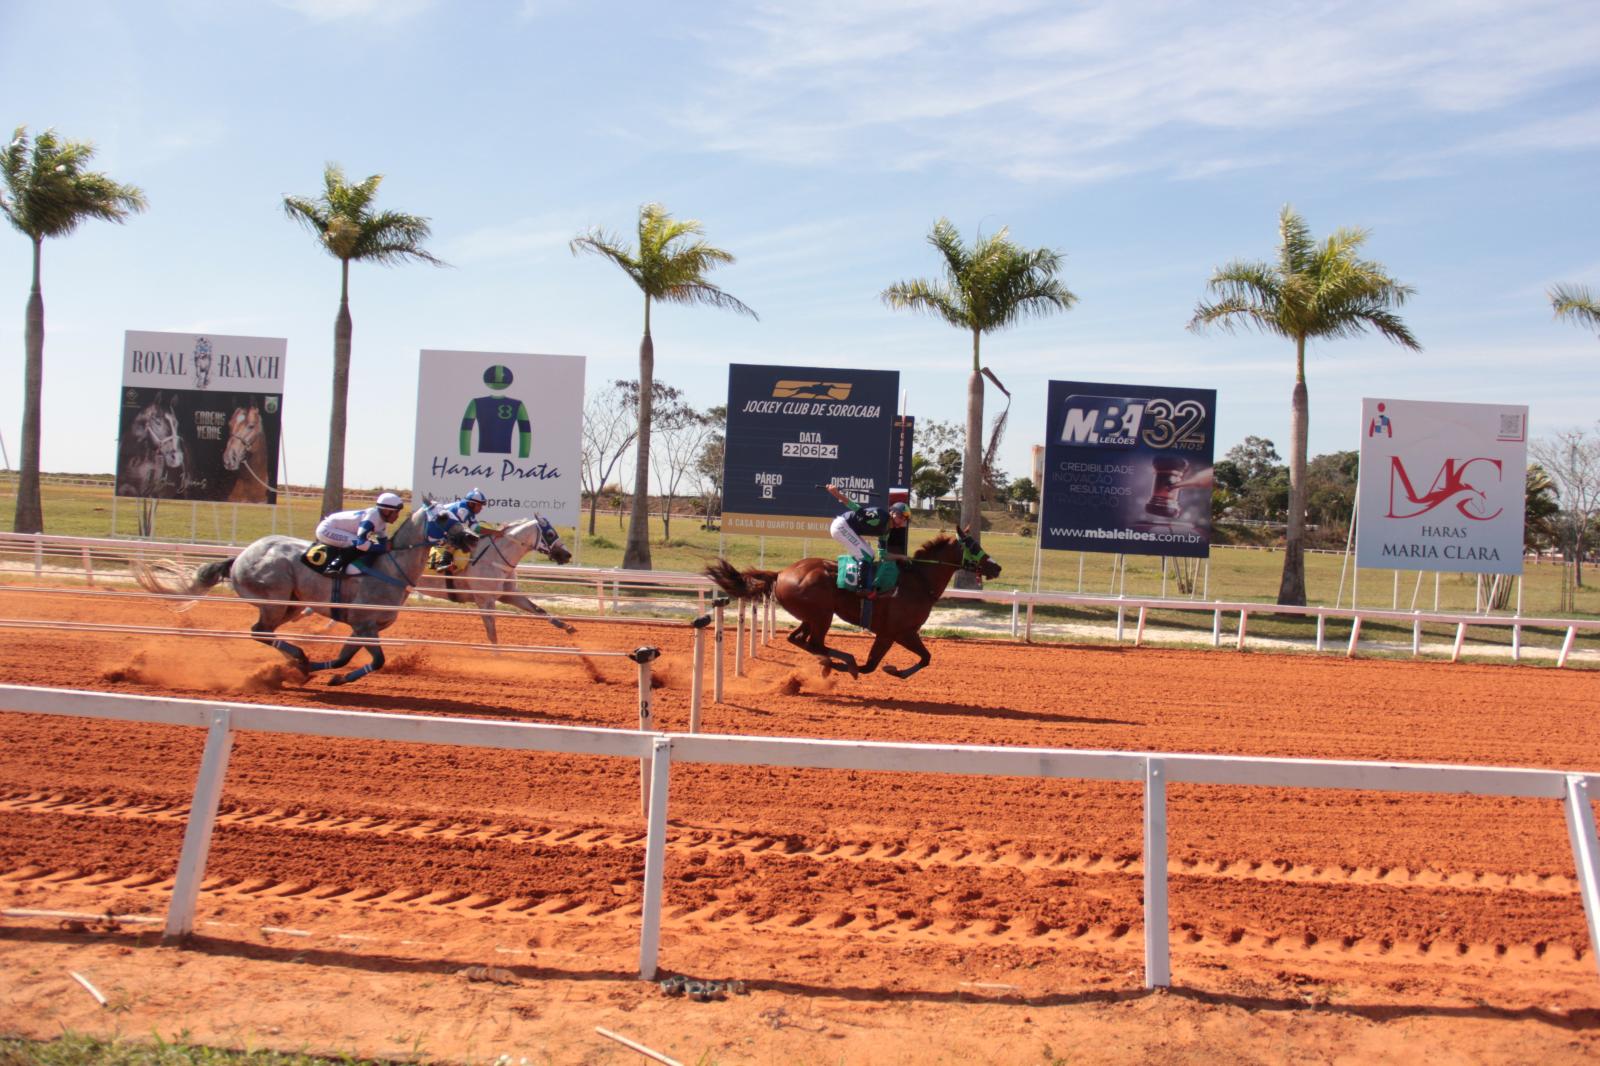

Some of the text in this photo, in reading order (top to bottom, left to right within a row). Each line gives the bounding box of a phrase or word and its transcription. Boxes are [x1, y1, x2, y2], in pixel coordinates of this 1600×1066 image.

[132, 350, 280, 380] ROYAL RANCH
[742, 400, 881, 418] JOCKEY CLUB DE SOROCABA
[1061, 403, 1144, 444] MBA
[1142, 399, 1206, 449] 32
[799, 432, 822, 444] DATA
[432, 456, 561, 482] Haras Prata
[1060, 461, 1135, 475] CREDIBILIDADE
[755, 472, 783, 485] PÁREO
[831, 476, 875, 490] DISTÂNCIA
[764, 486, 772, 497] 6
[1070, 484, 1133, 496] RESULTADOS
[735, 519, 753, 527] CASA
[755, 520, 765, 528] DO
[767, 520, 793, 529] QUARTO
[796, 521, 805, 530] DE
[1421, 526, 1467, 538] HARAS
[1050, 527, 1201, 544] www.mbaleiloes.com.br
[1382, 543, 1501, 561] MARIA CLARA
[640, 700, 649, 719] 8
